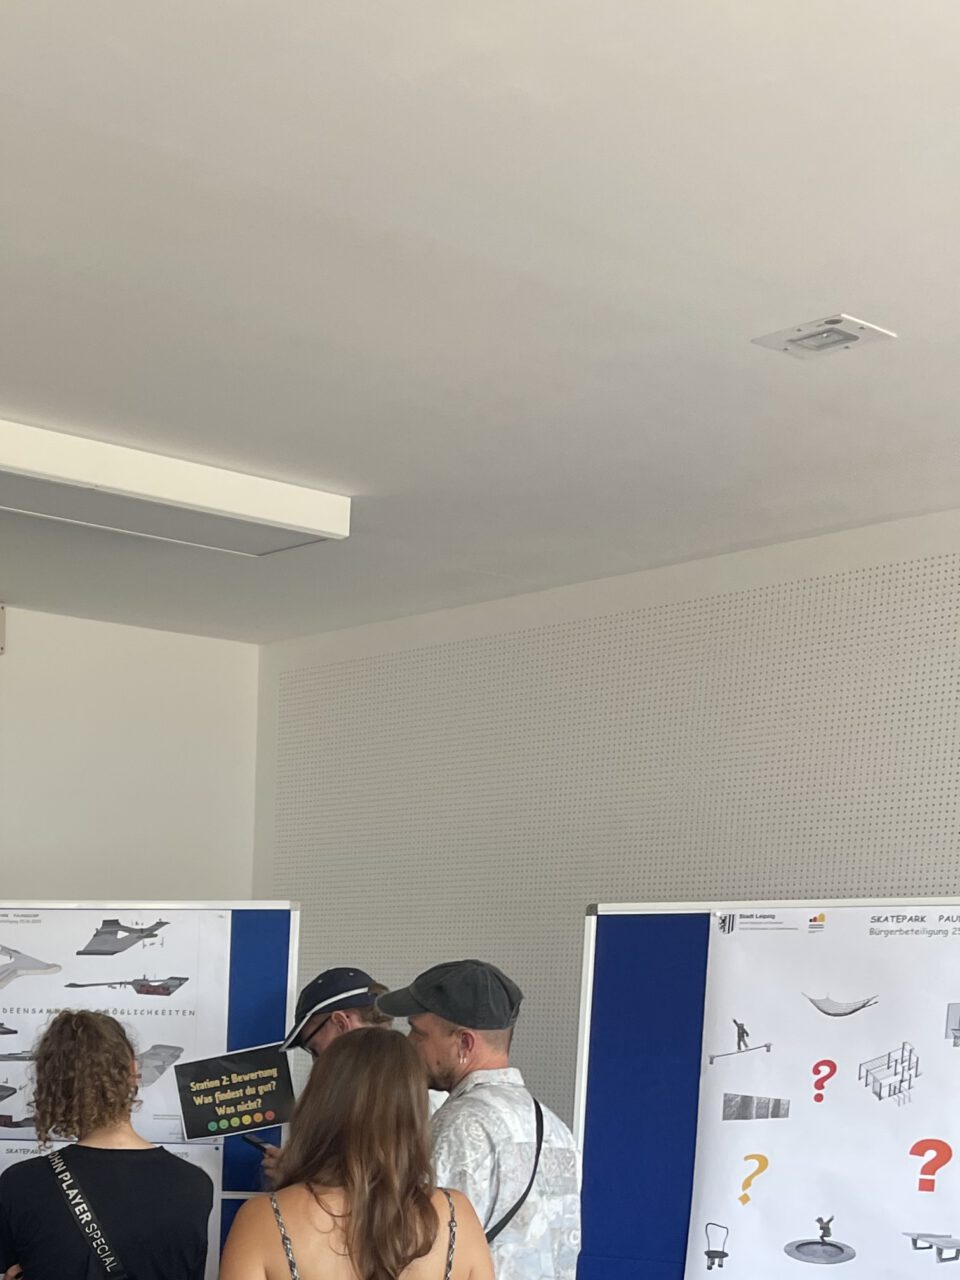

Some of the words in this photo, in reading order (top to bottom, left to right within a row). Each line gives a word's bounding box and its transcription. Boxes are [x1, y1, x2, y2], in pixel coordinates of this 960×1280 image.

[869, 914, 927, 923] SKATEPARK
[869, 927, 949, 937] Bürgerbeteiligung
[189, 1078, 220, 1092] Station
[221, 1075, 230, 1086] 2:
[230, 1067, 278, 1084] Bewertung
[192, 1095, 213, 1106] Was
[214, 1088, 244, 1104] findest
[245, 1085, 256, 1096] du
[257, 1080, 277, 1096] gut?
[214, 1105, 236, 1116] Was
[236, 1098, 262, 1112] nicht?
[48, 1151, 67, 1174] OHN
[58, 1171, 92, 1224] PLAYER
[85, 1223, 118, 1273] SPECIAL
